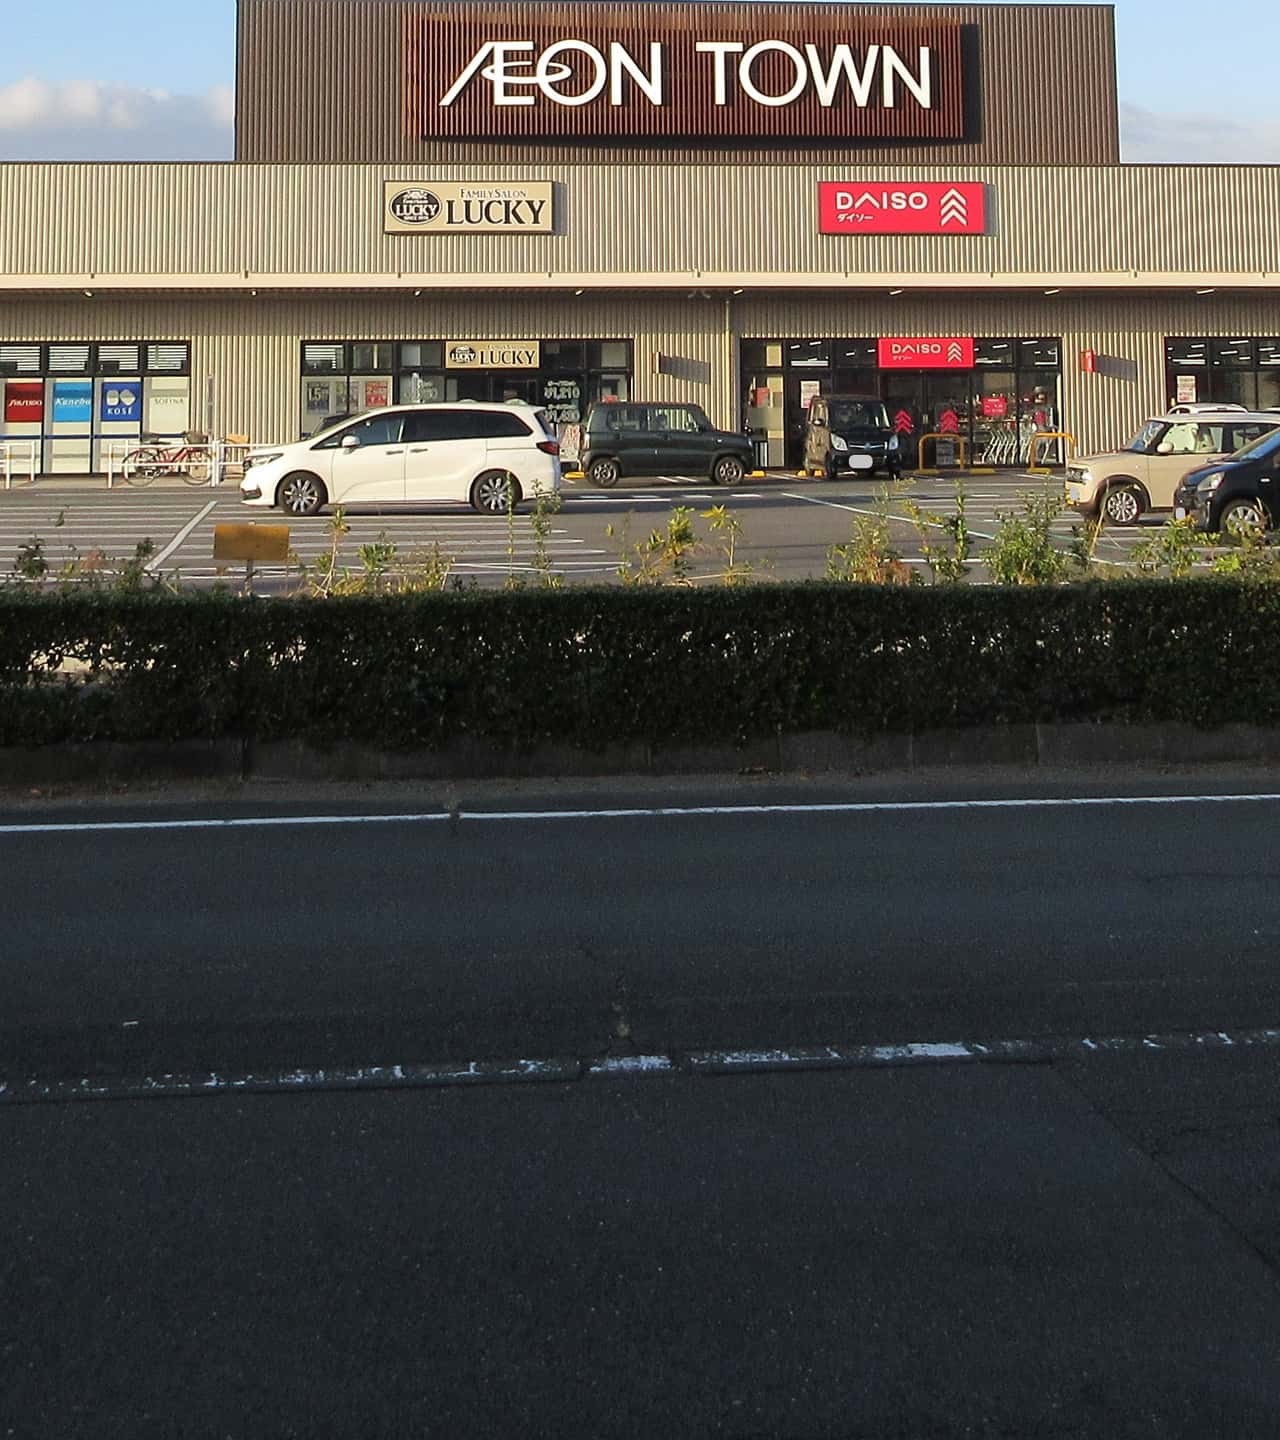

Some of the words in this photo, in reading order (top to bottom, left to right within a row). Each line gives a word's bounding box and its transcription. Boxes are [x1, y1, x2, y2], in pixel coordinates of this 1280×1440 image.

[696, 39, 931, 108] TOWN
[460, 188, 493, 198] FAMILY
[495, 188, 527, 198] SALON
[836, 191, 928, 210] DAISO
[396, 204, 438, 216] LUCKY
[446, 199, 546, 225] LUCKY
[837, 213, 873, 223] ダイソー
[892, 343, 941, 354] DAISO
[480, 350, 536, 365] LUCKY
